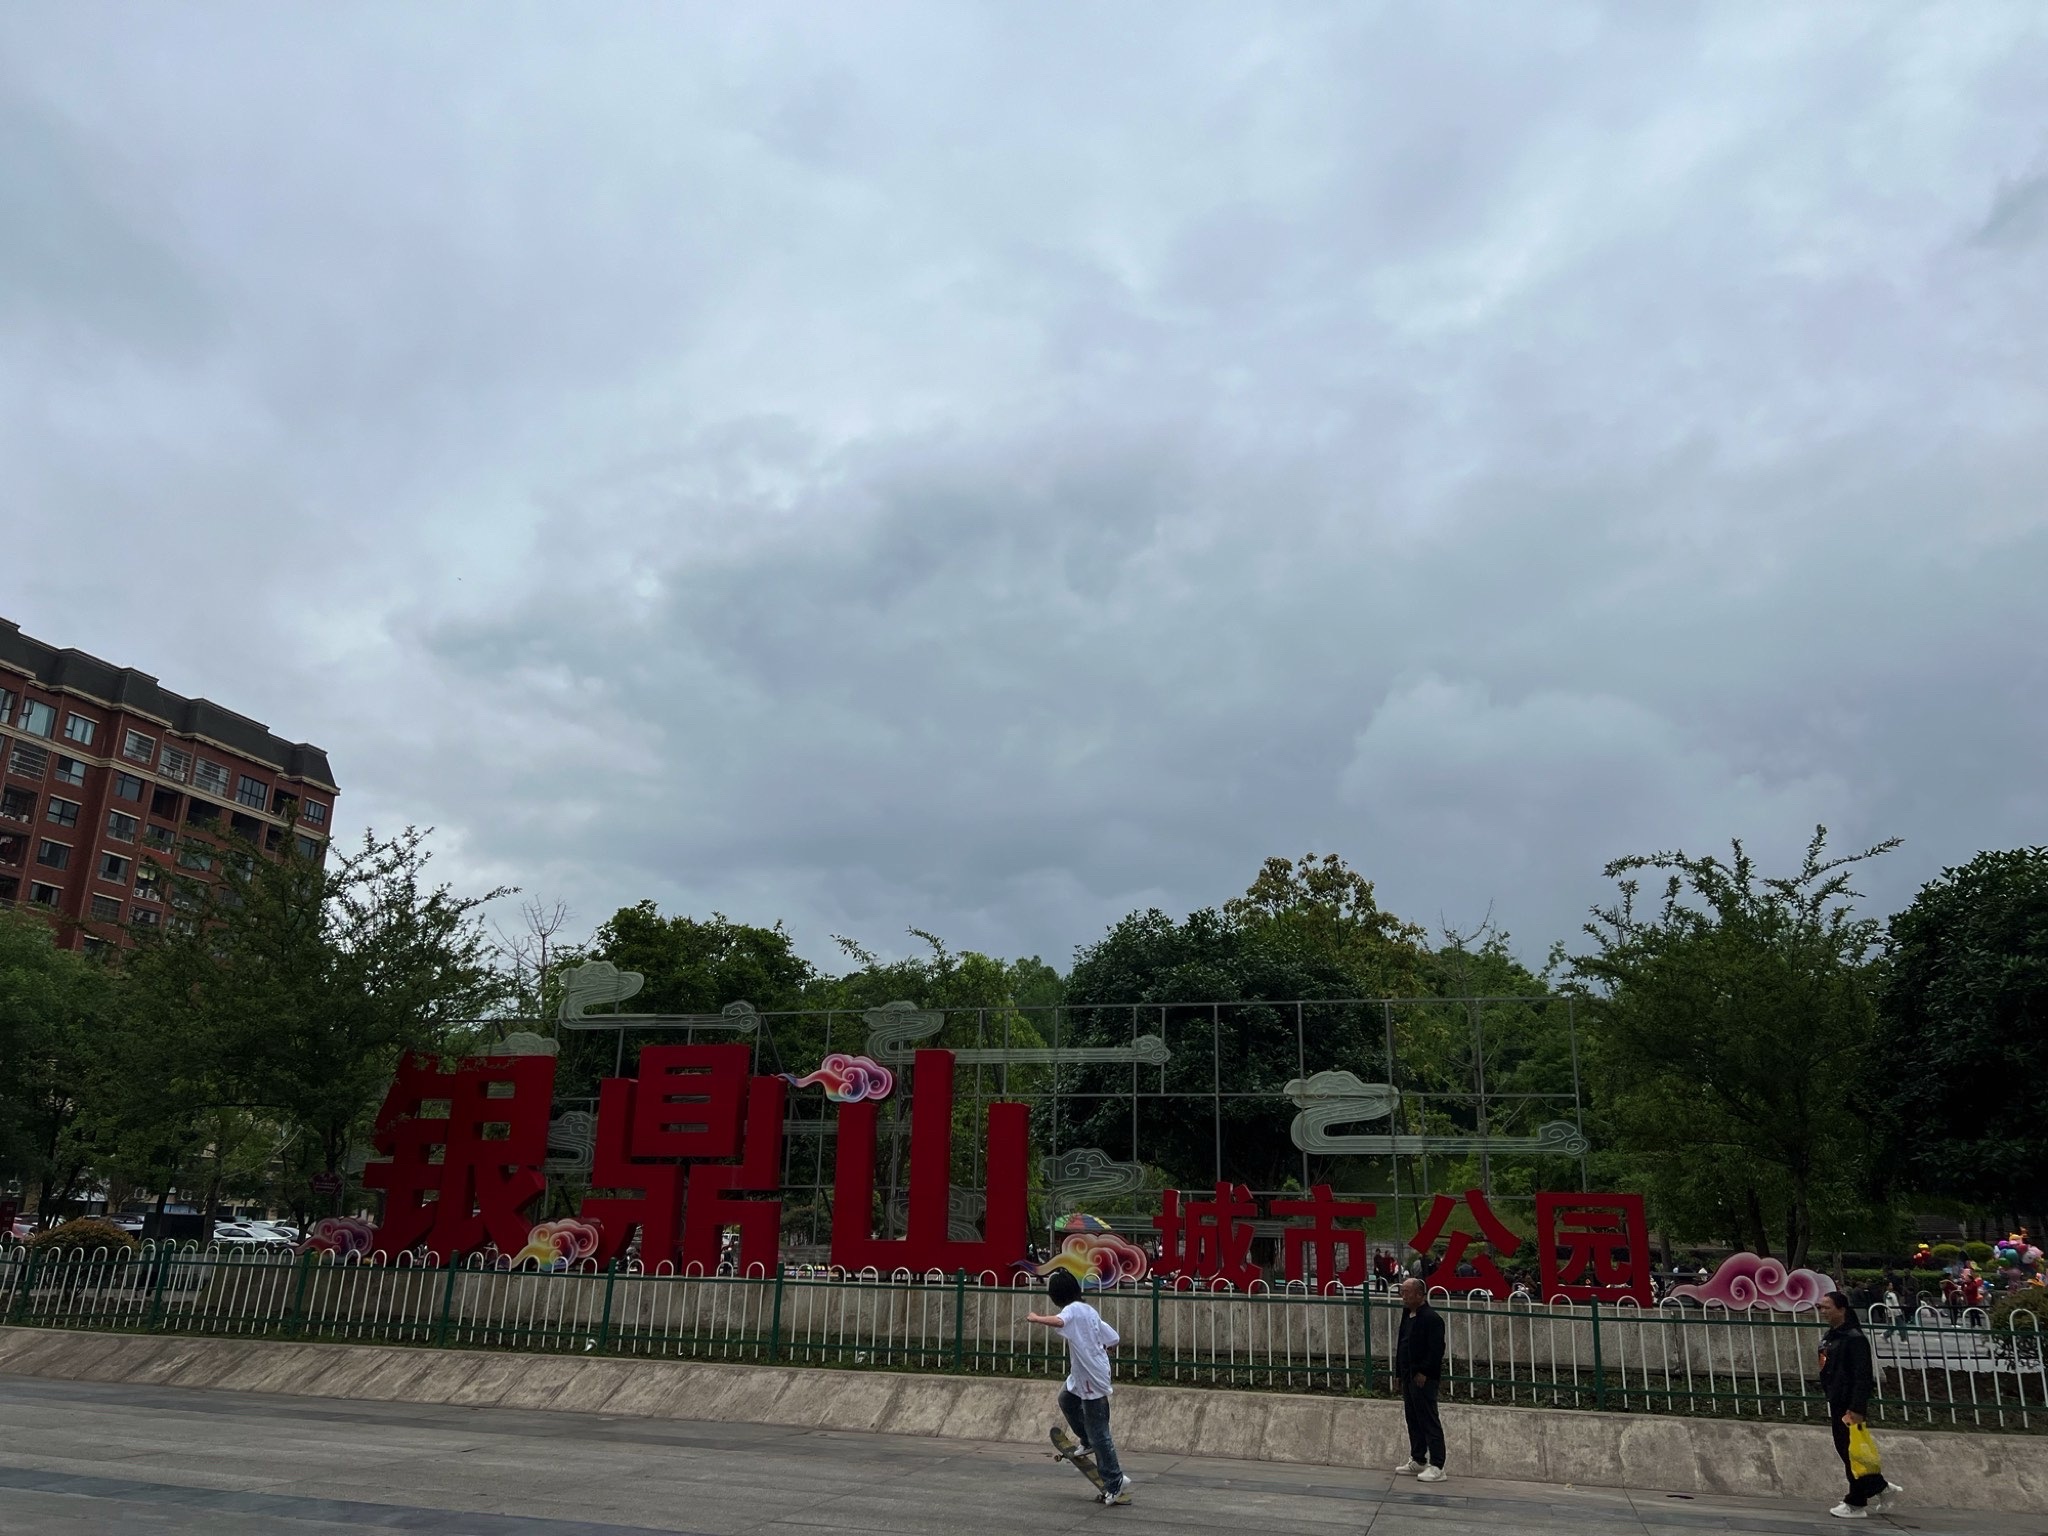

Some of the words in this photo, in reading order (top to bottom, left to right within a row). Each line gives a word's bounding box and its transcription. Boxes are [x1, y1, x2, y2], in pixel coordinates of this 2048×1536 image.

[363, 1046, 1029, 1285] 银鼎山
[1152, 1183, 1652, 1307] 城市公园
